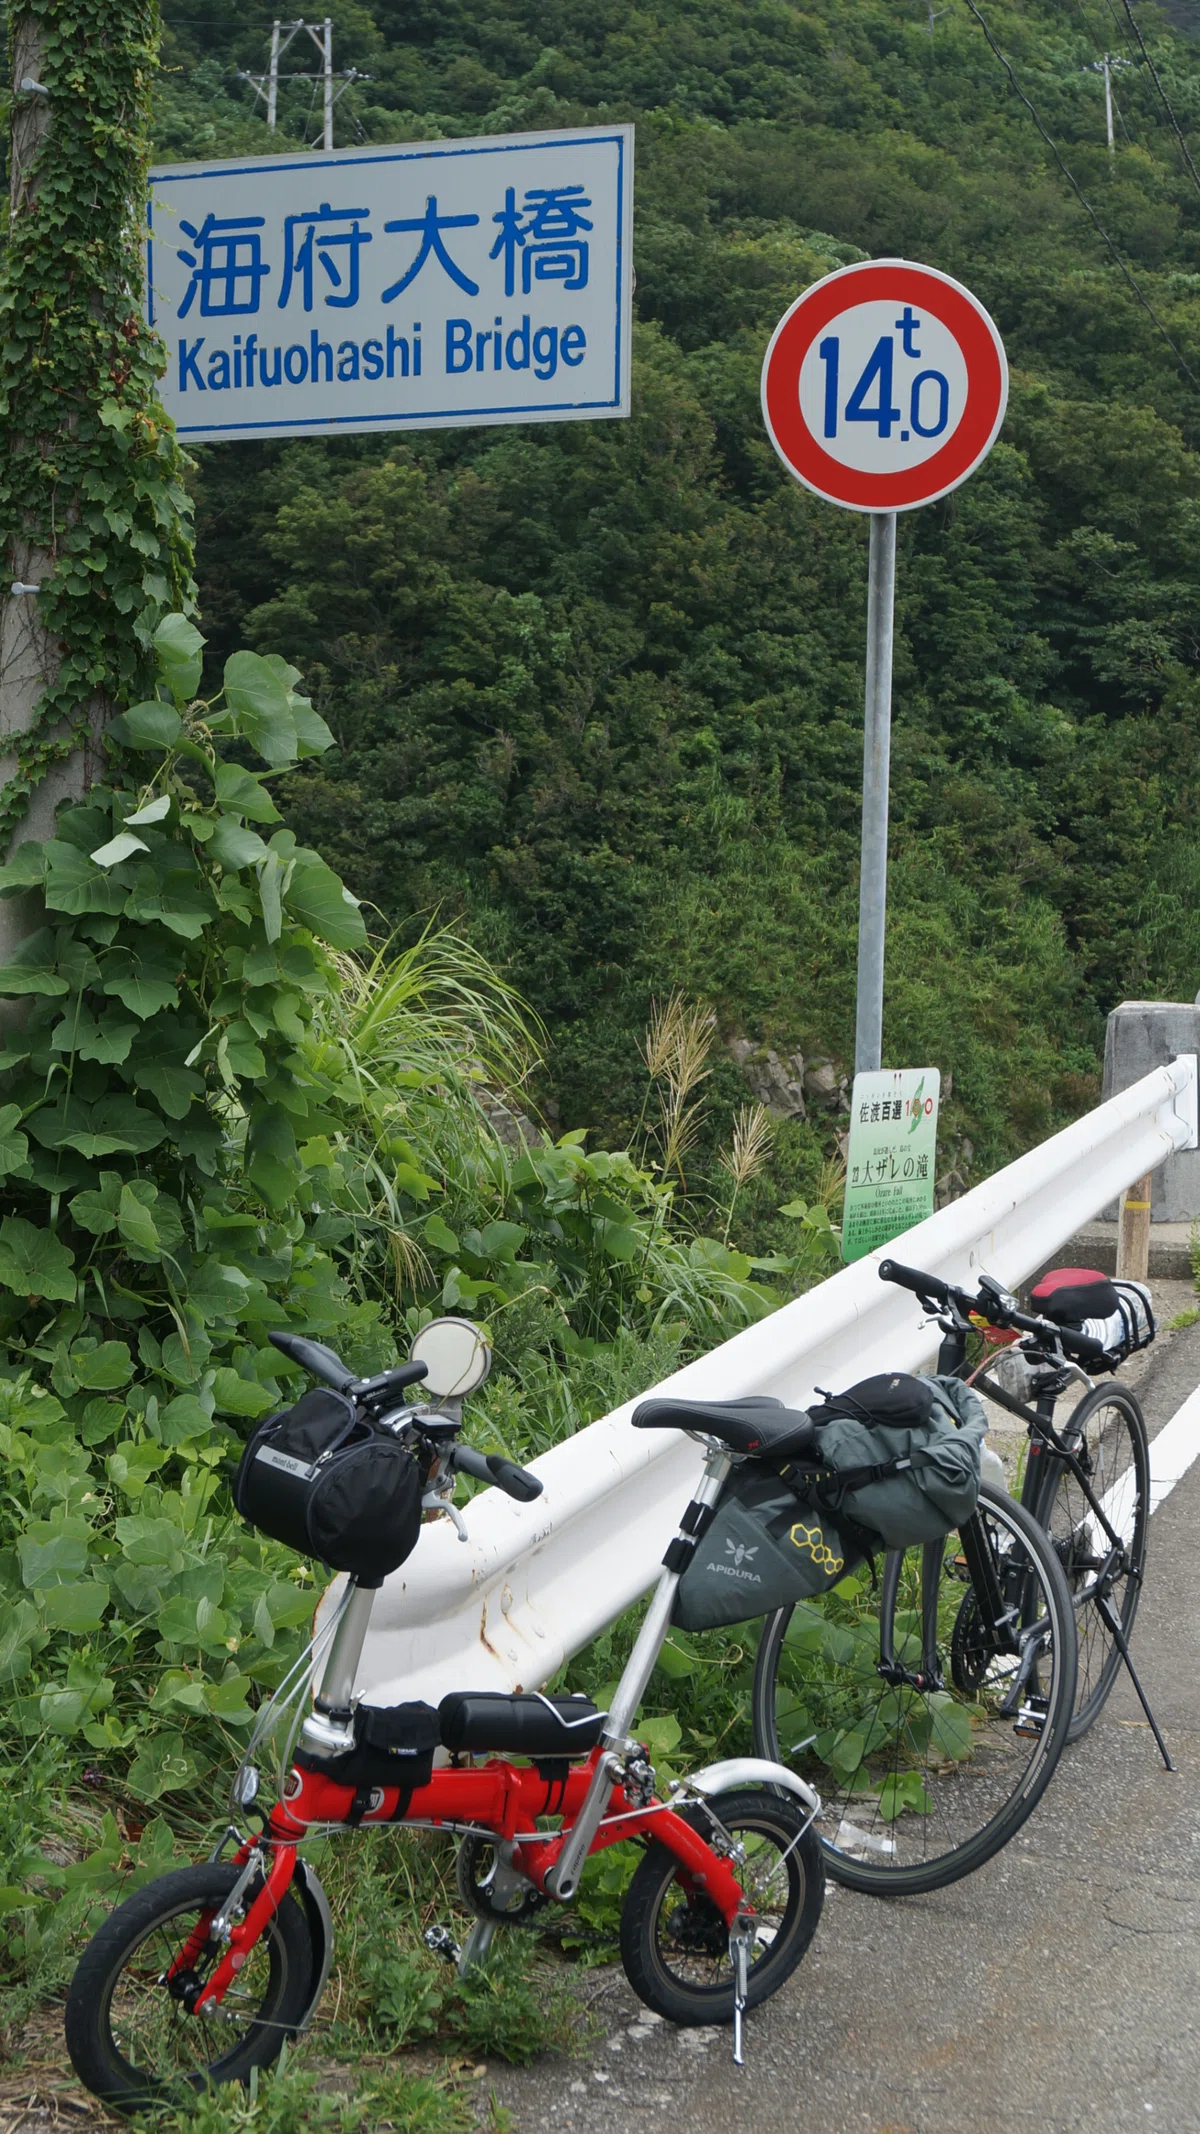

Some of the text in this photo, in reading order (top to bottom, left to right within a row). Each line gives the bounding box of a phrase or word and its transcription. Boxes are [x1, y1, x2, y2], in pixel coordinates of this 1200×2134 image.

[177, 184, 593, 319] 海府大橋
[178, 314, 587, 392] Kaifuohashi Bridge
[895, 307, 921, 358] t
[819, 336, 948, 441] 14.0
[860, 1101, 902, 1123] 佐渡百選
[861, 1153, 929, 1184] 大ザレの滝
[707, 1563, 761, 1583] APIDURA
